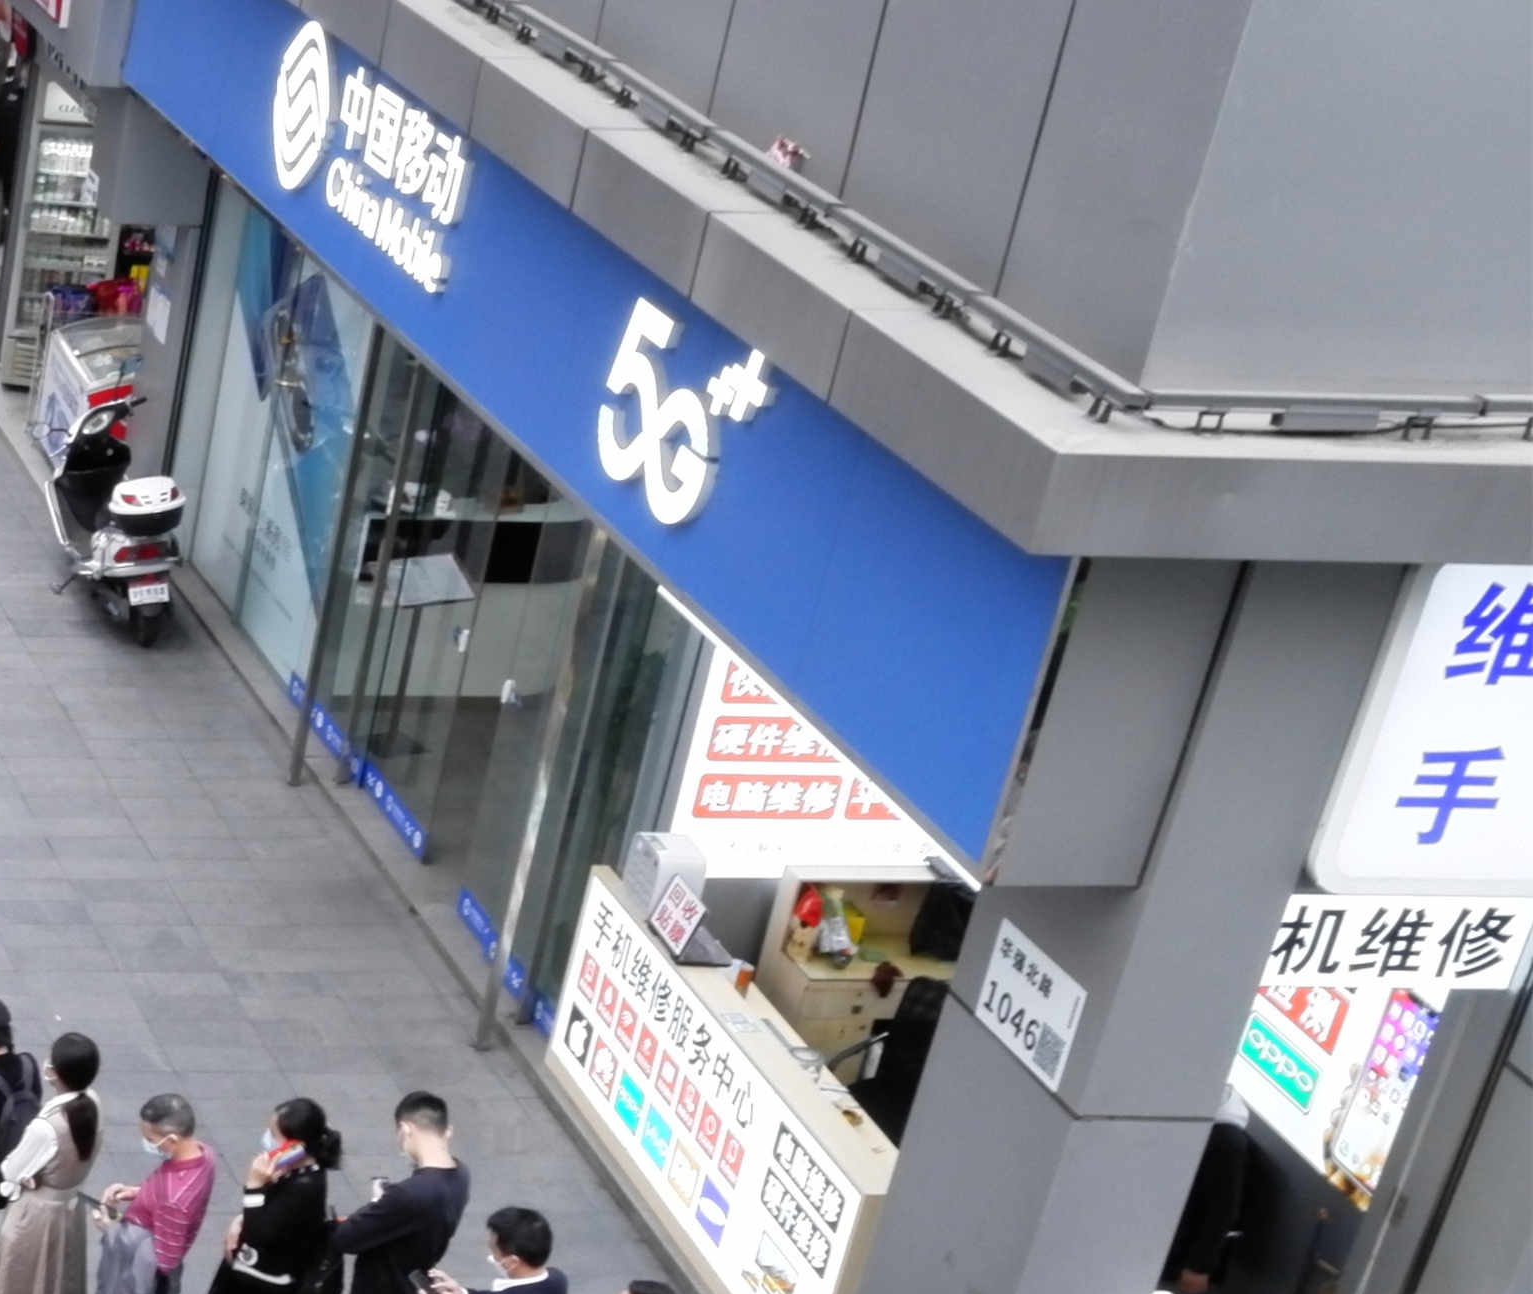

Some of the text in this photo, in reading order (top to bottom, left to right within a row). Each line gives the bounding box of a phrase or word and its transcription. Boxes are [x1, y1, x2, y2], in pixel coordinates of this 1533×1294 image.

[339, 66, 467, 226] 中国移动
[325, 157, 442, 293] China Mobile
[699, 780, 839, 814] 电脑维修
[1395, 746, 1506, 845] 手
[999, 937, 1054, 998] 华强北路
[1270, 904, 1516, 979] 机维修
[593, 901, 755, 1130] 手机维修服务中心
[983, 980, 1041, 1051] 1046
[1246, 1028, 1313, 1092] oppo
